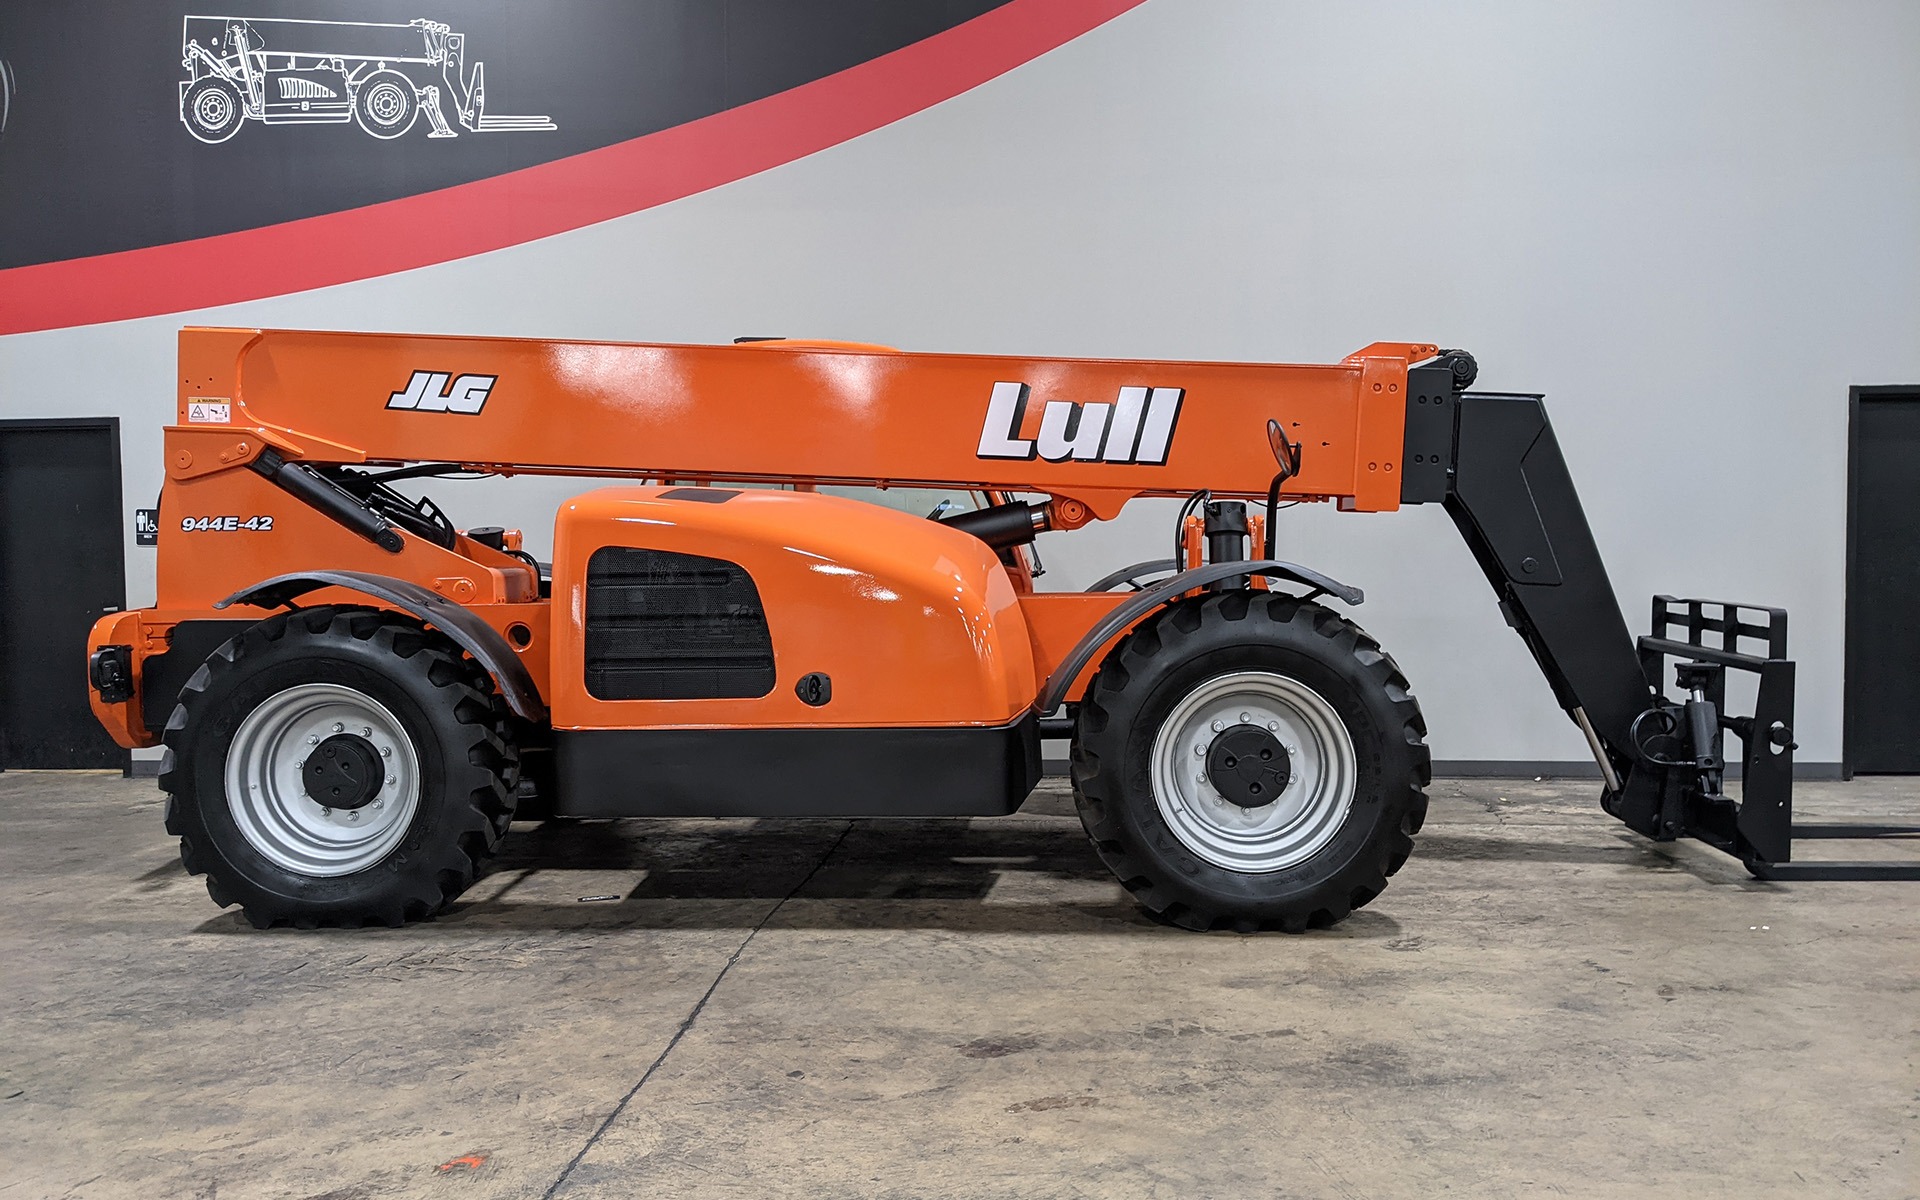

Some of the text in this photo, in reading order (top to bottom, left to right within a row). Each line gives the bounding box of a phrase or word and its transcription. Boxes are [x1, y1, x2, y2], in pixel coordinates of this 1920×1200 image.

[384, 369, 499, 416] JLG
[975, 381, 1186, 466] Lull
[181, 516, 274, 532] 944E-42
